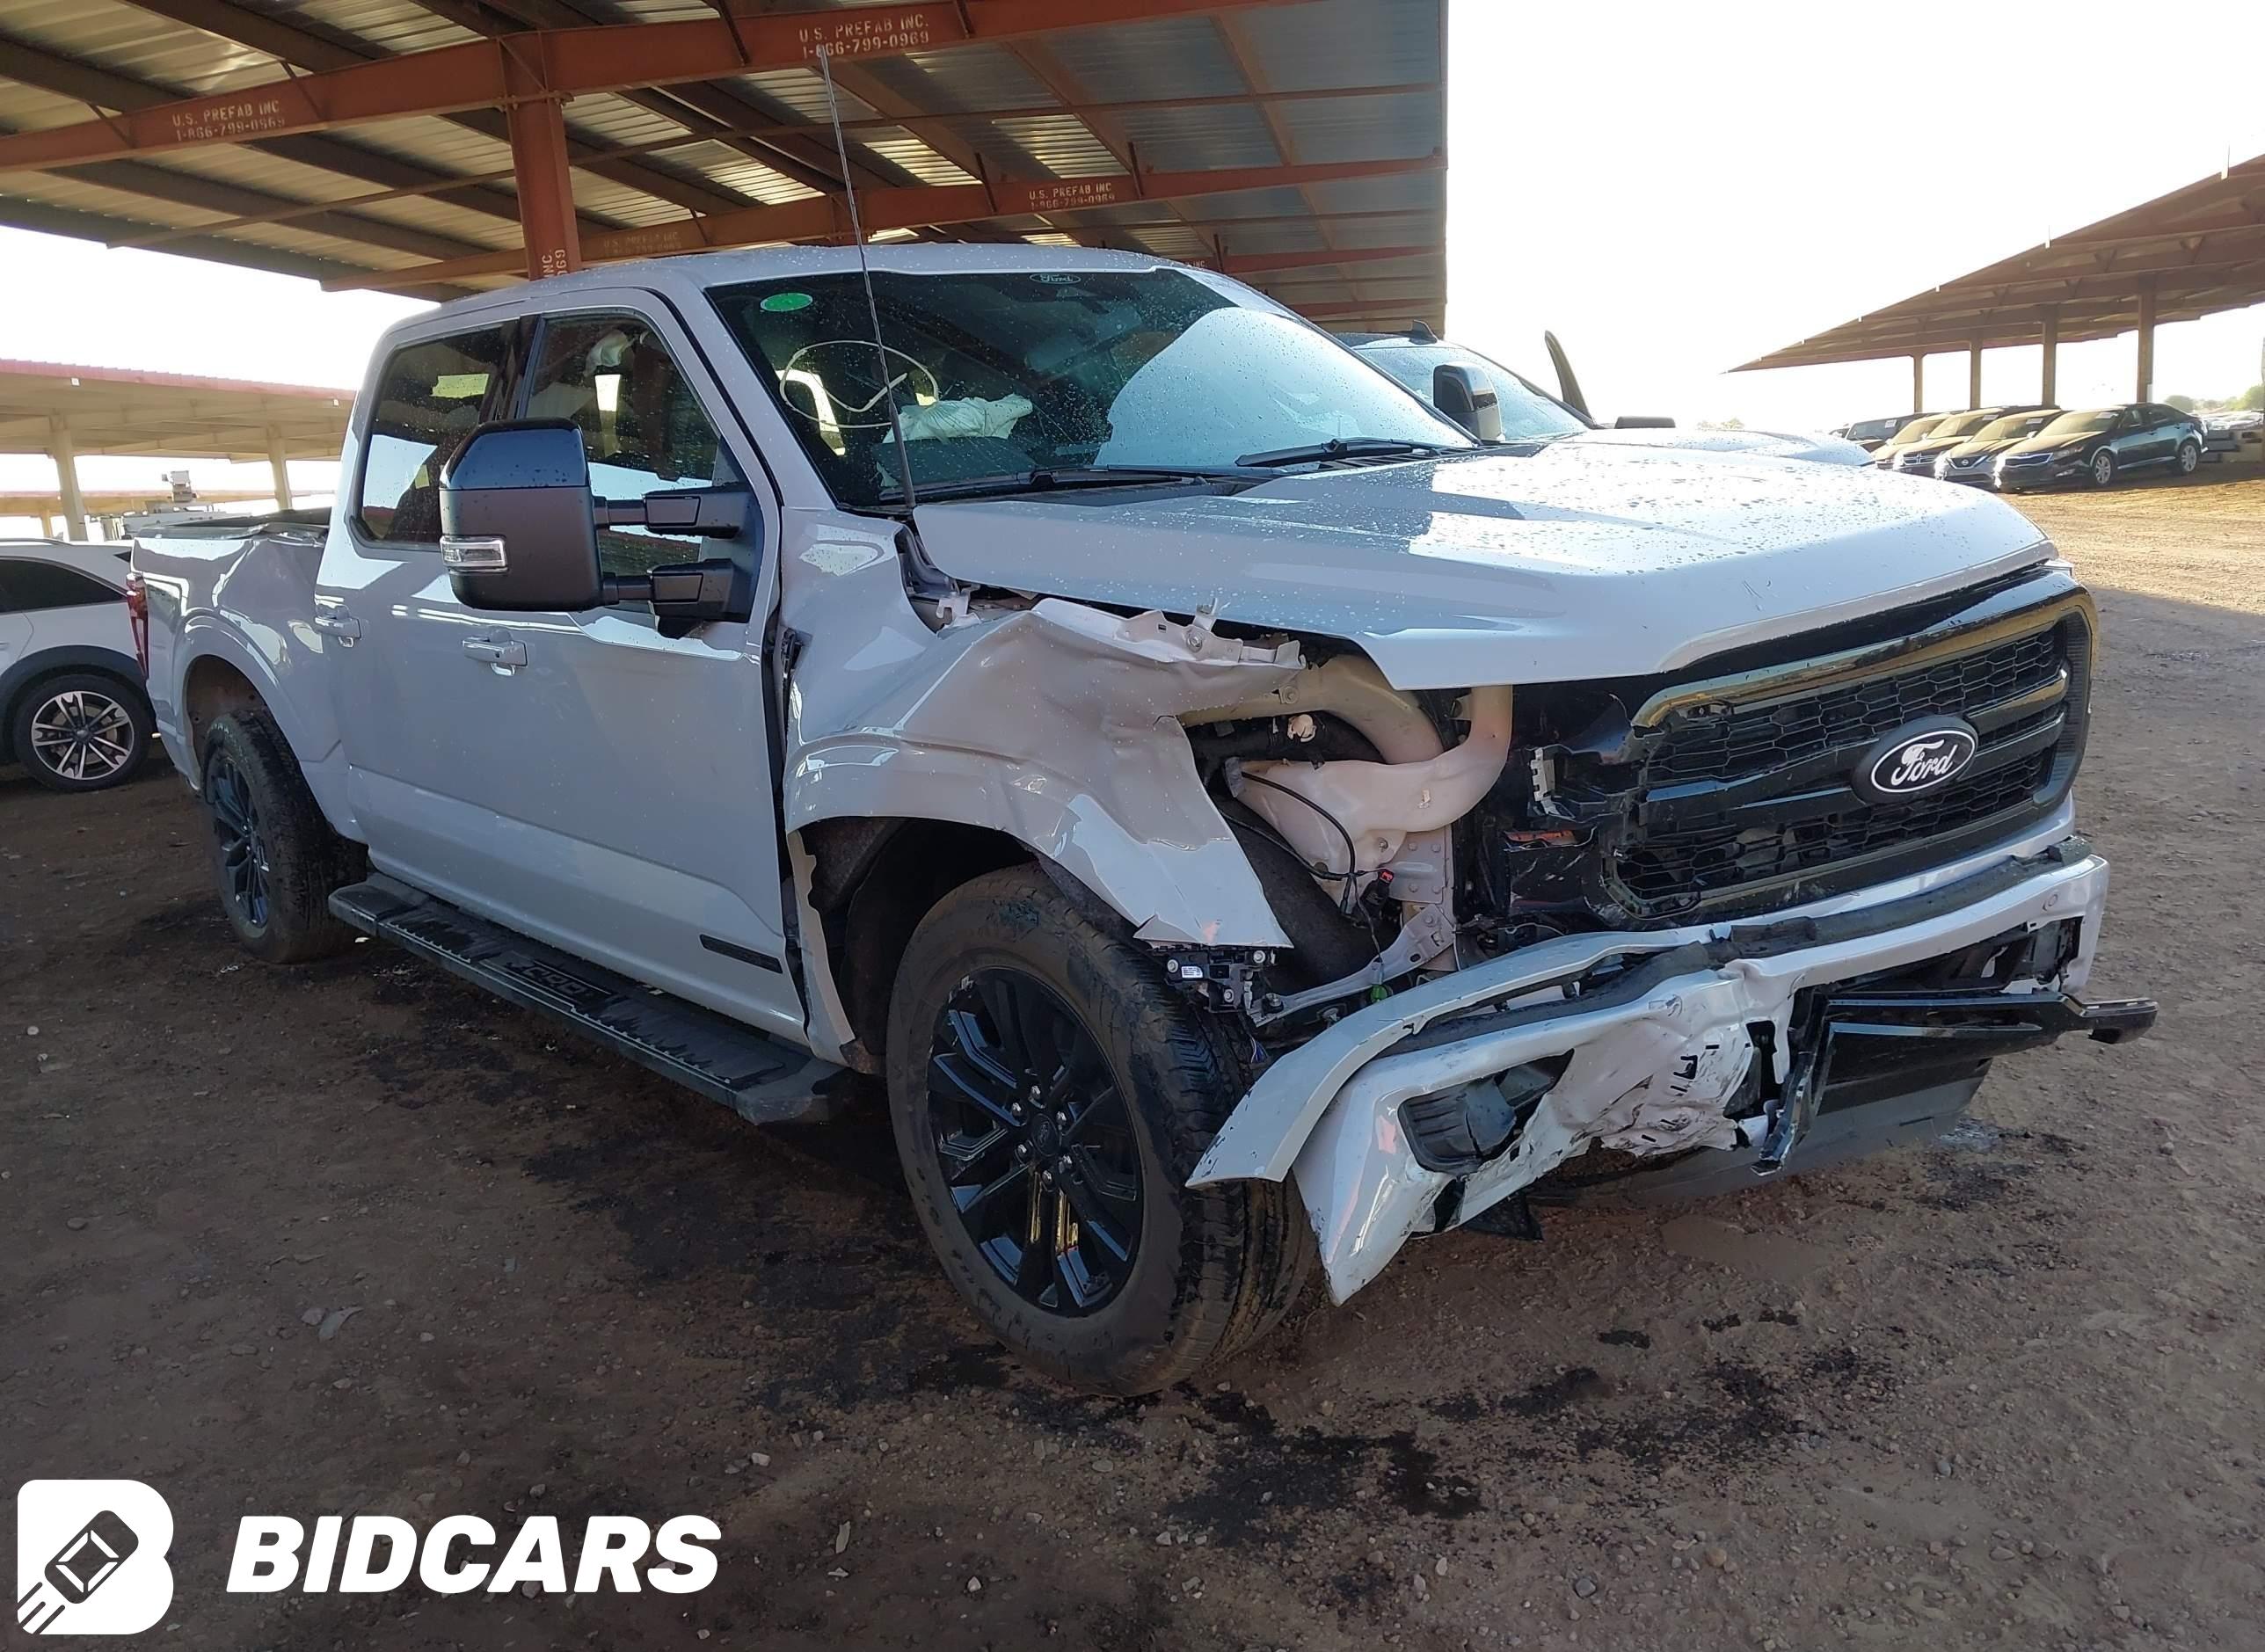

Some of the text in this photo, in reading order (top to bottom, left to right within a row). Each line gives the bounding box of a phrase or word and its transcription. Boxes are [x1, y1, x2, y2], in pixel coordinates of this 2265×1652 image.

[799, 13, 929, 43] U.S. PREFAB INC.
[172, 113, 198, 127] U.S.
[203, 103, 253, 122] PREFAB
[1052, 184, 1091, 198] PREFAB
[1891, 739, 1958, 786] Ford
